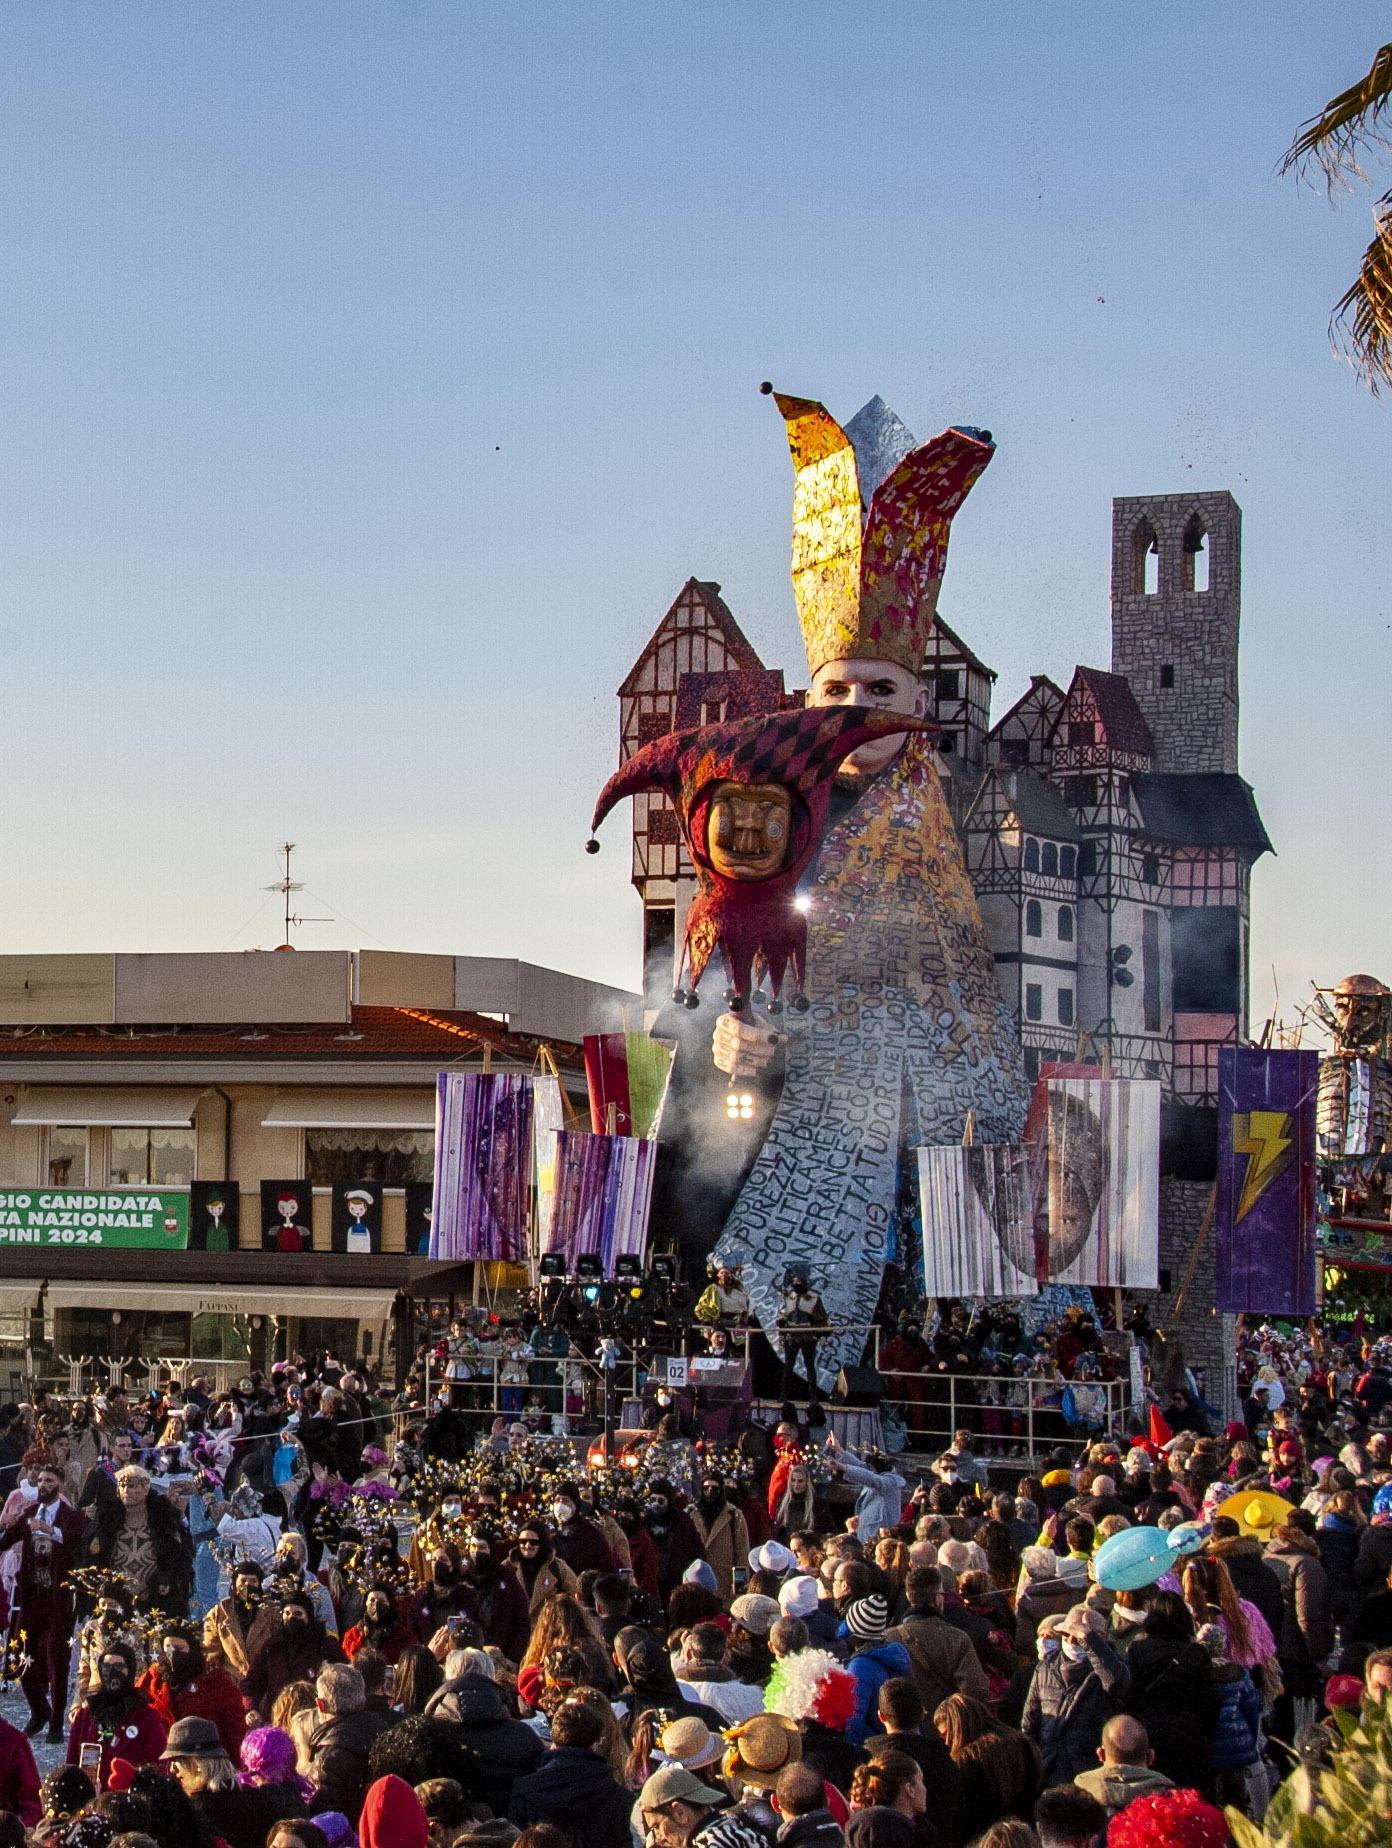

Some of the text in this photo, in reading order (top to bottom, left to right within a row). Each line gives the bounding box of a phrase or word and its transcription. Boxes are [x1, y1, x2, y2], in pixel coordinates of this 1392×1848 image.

[854, 1086, 897, 1168] TUDOR
[755, 1089, 851, 1271] POLITICAMENTE
[800, 1094, 870, 1241] FRANCESCO
[27, 1211, 154, 1228] NAZIONALE
[38, 1195, 164, 1212] CANDIDATA
[734, 1145, 806, 1249] PUREZZA
[47, 1229, 103, 1244] 2024
[669, 1366, 684, 1378] 02
